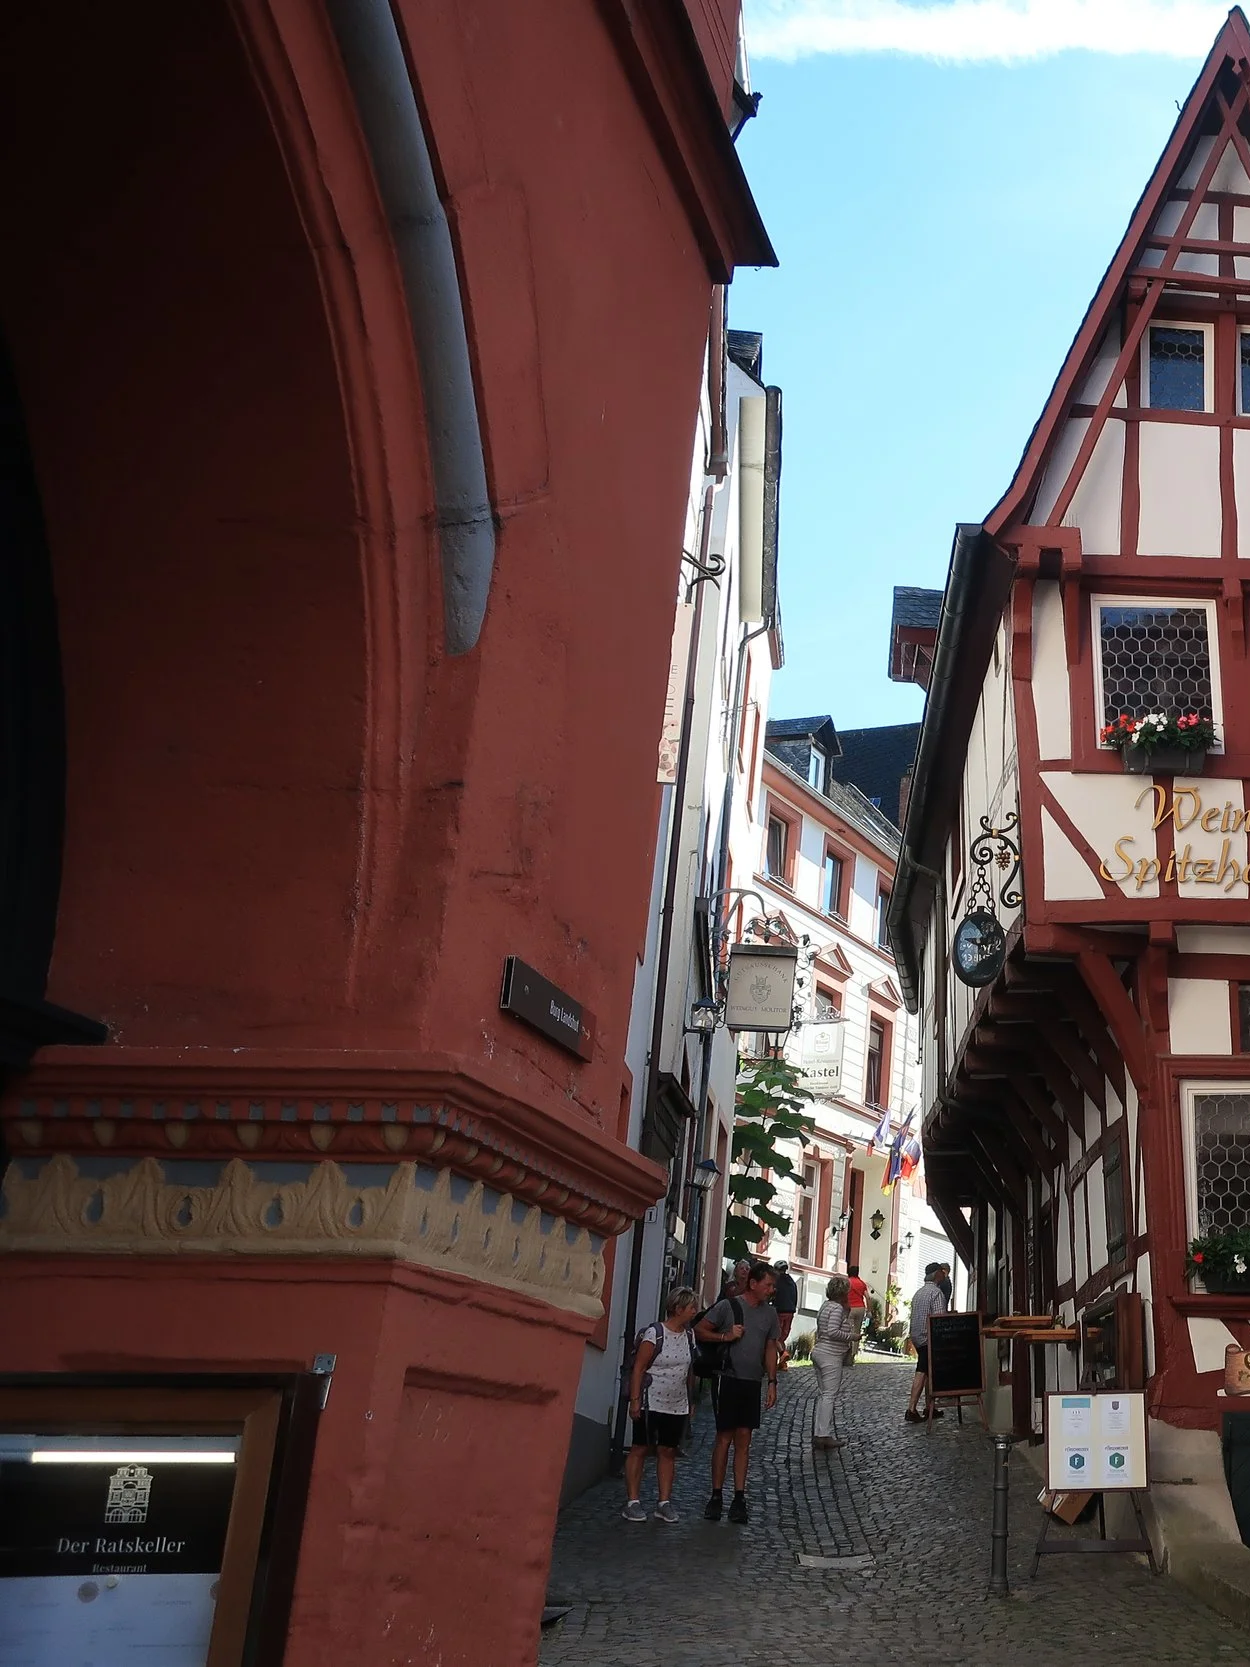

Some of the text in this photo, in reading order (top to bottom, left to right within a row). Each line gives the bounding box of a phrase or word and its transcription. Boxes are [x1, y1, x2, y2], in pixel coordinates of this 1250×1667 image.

[801, 1066, 839, 1078] Kastel
[57, 1536, 185, 1553] Der Ratskeller
[92, 1563, 147, 1573] Restaurant
